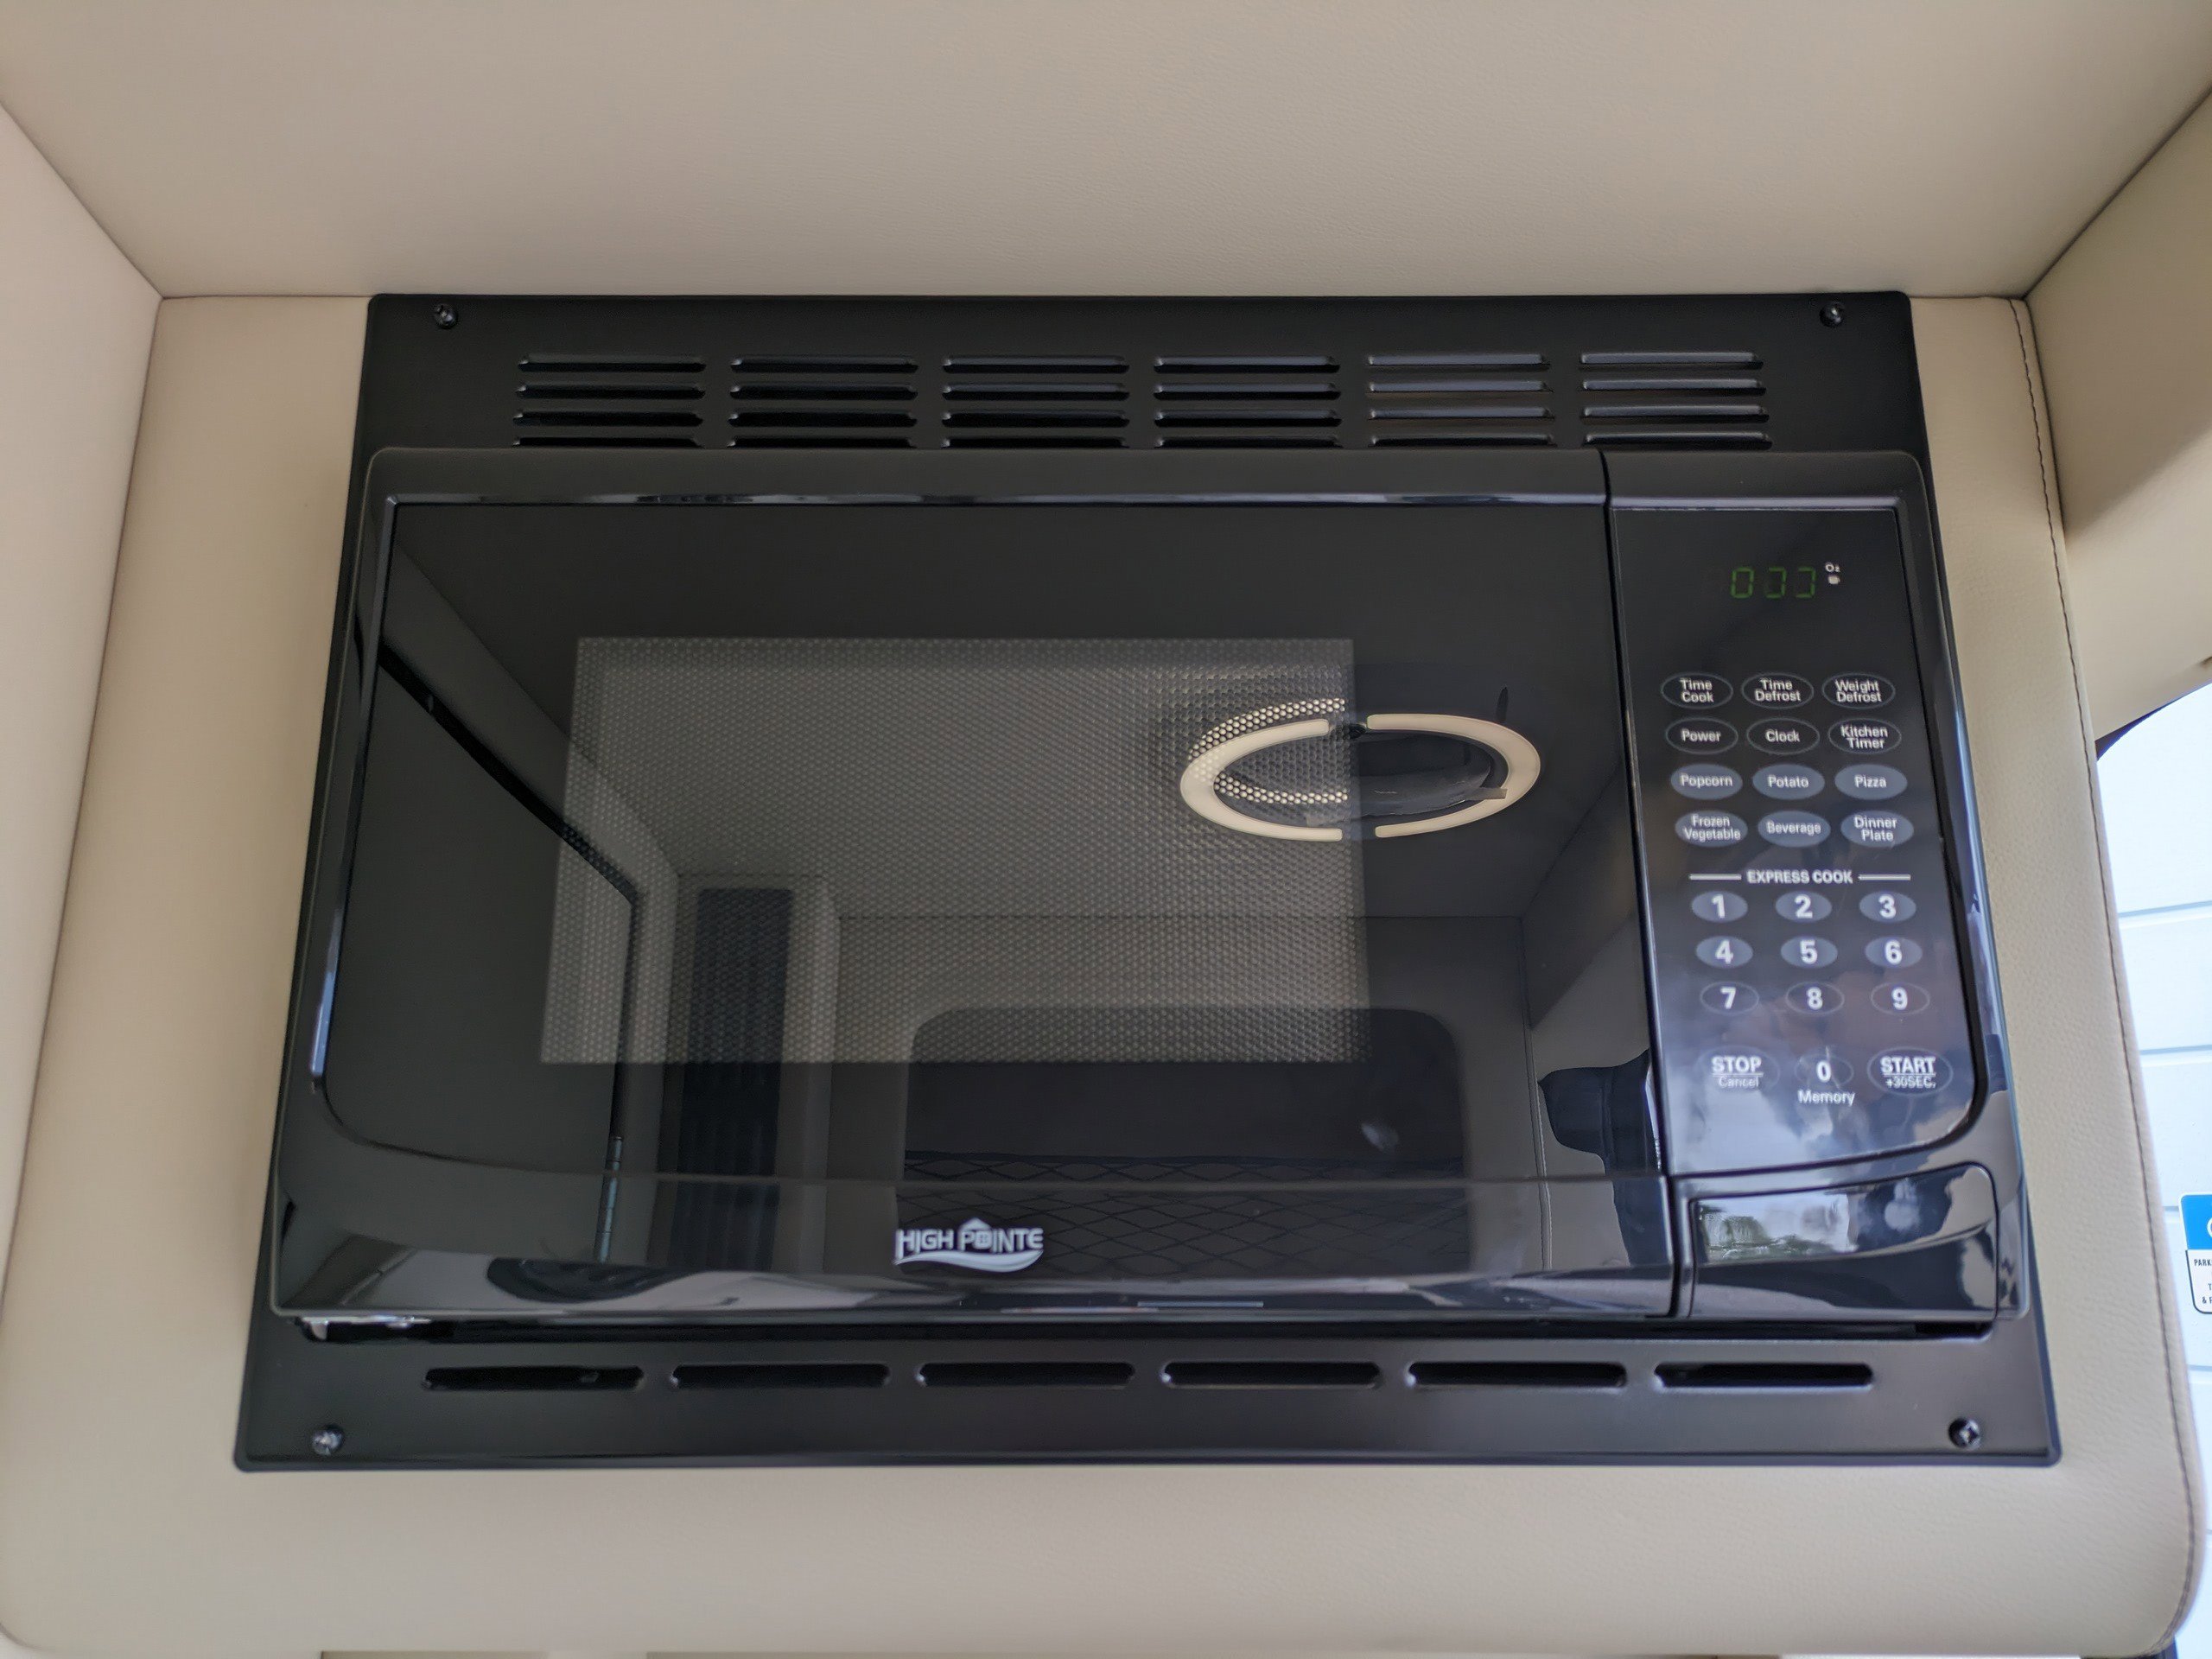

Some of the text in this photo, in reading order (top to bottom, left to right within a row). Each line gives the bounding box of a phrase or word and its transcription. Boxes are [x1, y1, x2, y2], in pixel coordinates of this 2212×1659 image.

[1680, 677, 1713, 690] Time
[1759, 677, 1793, 690] Time
[1834, 679, 1879, 692] Weight
[1681, 690, 1714, 703] Cook
[1755, 690, 1801, 702] Defrost
[1836, 691, 1882, 702] Defrost
[1681, 730, 1721, 742] Power
[1765, 730, 1800, 742] Clock
[1840, 725, 1888, 738] Kitchen
[1847, 737, 1885, 749] Timer
[1680, 774, 1733, 788] Popcorn
[1768, 775, 1808, 788] Potato
[1854, 775, 1886, 788] Pizza
[1691, 814, 1730, 827] Frozen
[1853, 816, 1897, 829] Dinner
[1684, 827, 1741, 842] Vegetable
[1766, 821, 1821, 836] Beverage
[1861, 829, 1894, 842] Plate
[1746, 870, 1853, 884] EXPRESS COOK
[1711, 894, 1726, 918] 1
[1794, 894, 1813, 918] 2
[1878, 894, 1897, 918] 3
[1714, 939, 1733, 964] 4
[1799, 939, 1818, 964] 5
[1884, 939, 1903, 965] 6
[1719, 986, 1737, 1009] 7
[1806, 987, 1823, 1011] 8
[1891, 987, 1909, 1011] 9
[1711, 1055, 1763, 1073] STOP
[1880, 1056, 1936, 1073] START
[1816, 1060, 1832, 1083] 0
[1719, 1076, 1759, 1089] Cancel
[1798, 1089, 1856, 1107] Memory
[895, 1227, 1044, 1260] HIGH POINTE
